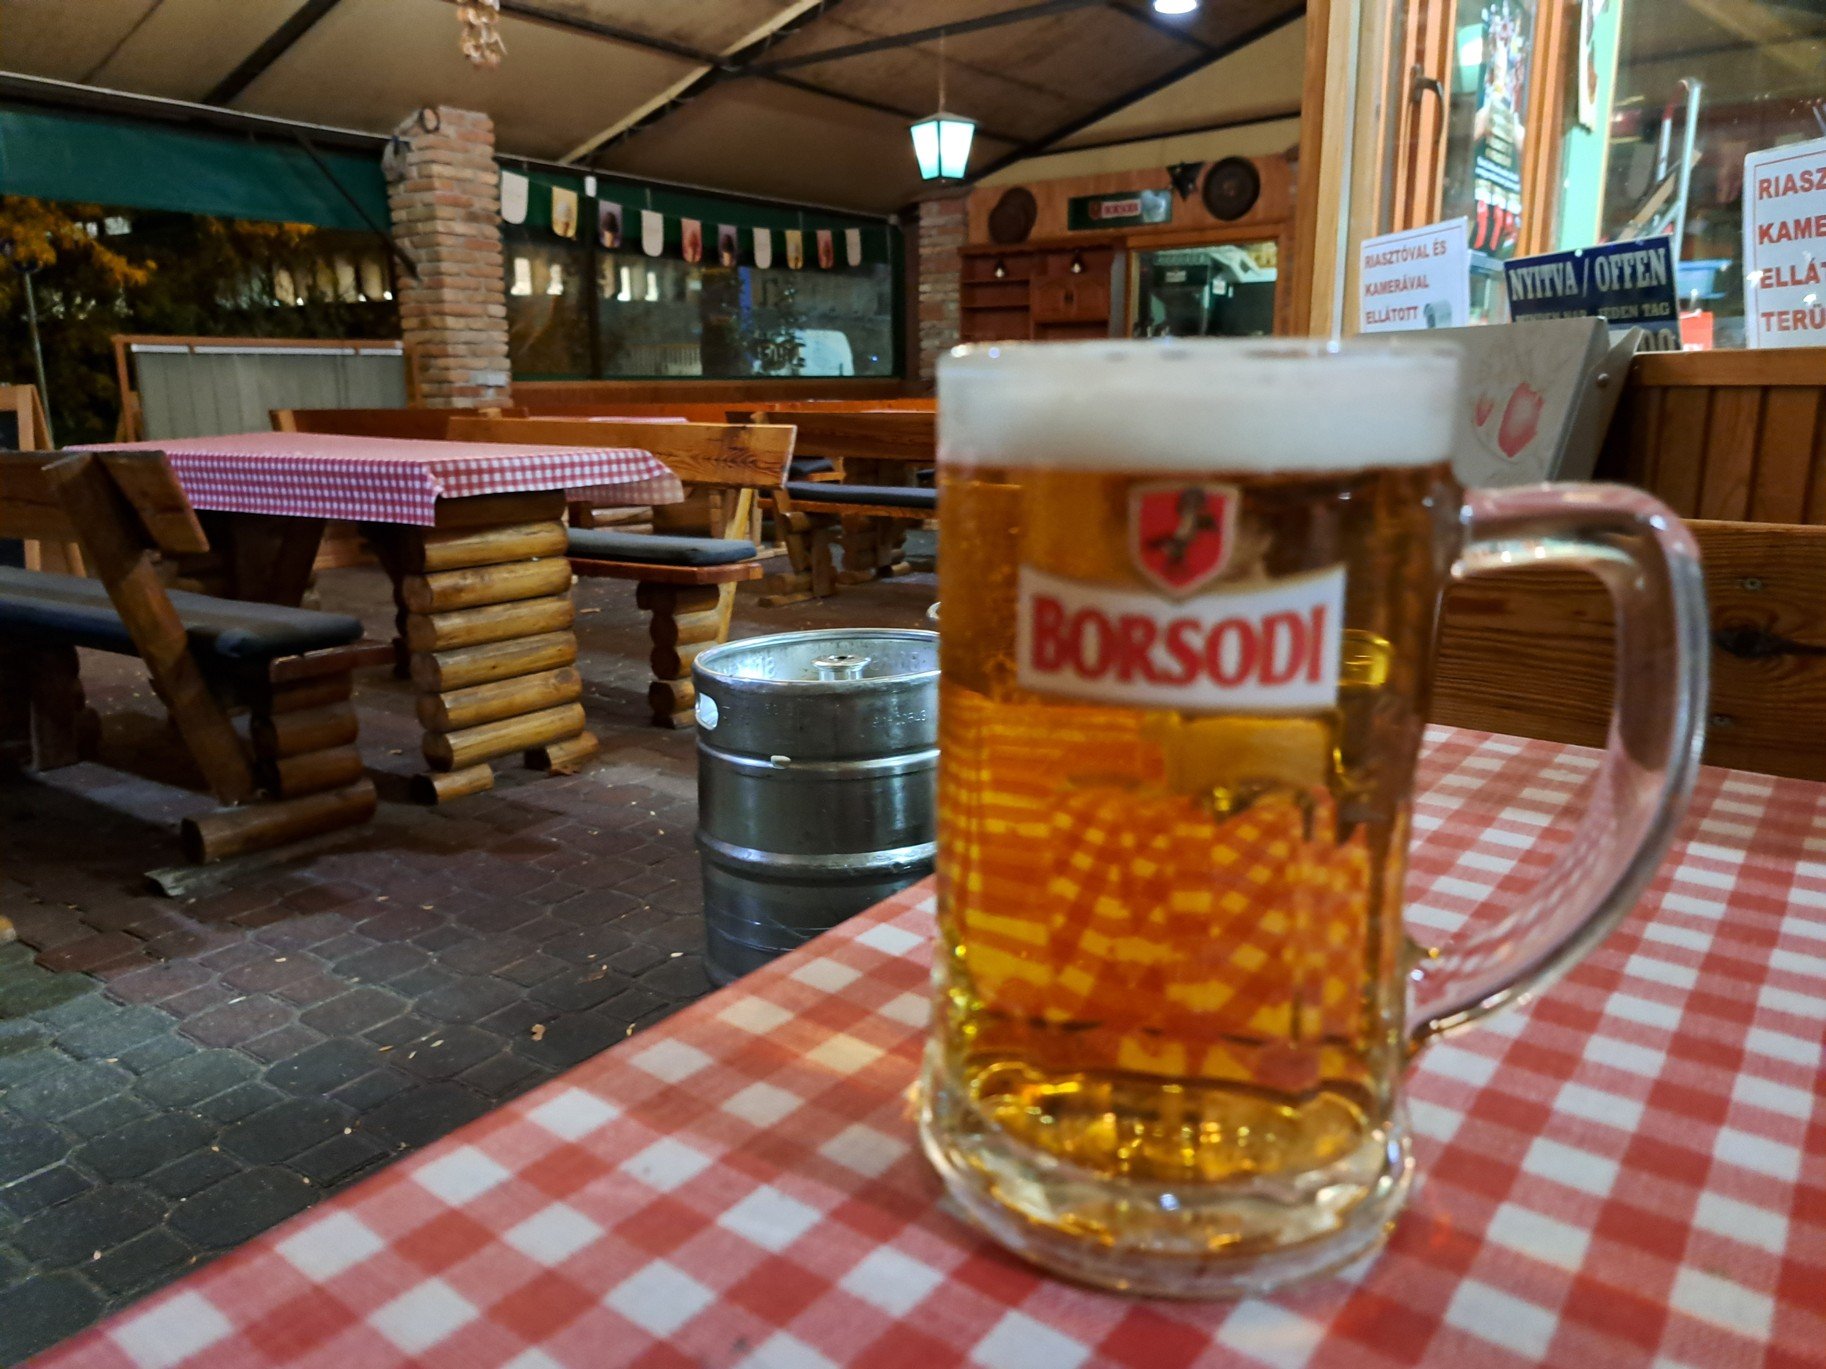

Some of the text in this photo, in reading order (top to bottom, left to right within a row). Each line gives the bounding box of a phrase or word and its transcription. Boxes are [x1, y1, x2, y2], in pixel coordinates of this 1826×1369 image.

[1758, 167, 1826, 200] RIASZ
[1758, 214, 1826, 245] KAME
[1364, 238, 1447, 269] RIASZTÓVAL ÉS
[1364, 275, 1430, 297] KAMERÁVAL
[1508, 247, 1667, 301] NYITVA / OFFEN
[1365, 305, 1420, 325] ELLÁTOTT
[1641, 302, 1670, 317] TAG
[1030, 592, 1327, 689] BORSODI
